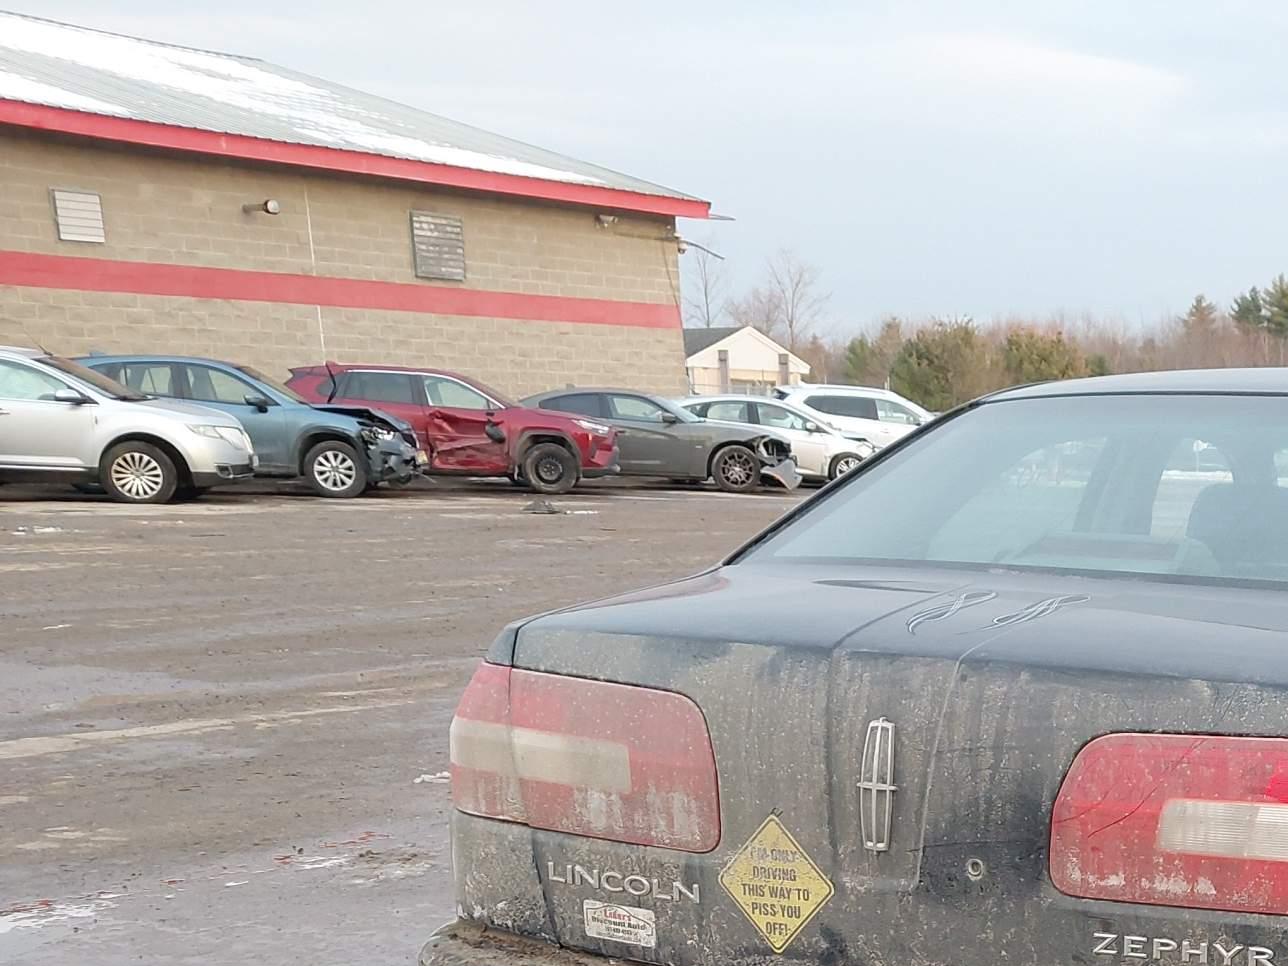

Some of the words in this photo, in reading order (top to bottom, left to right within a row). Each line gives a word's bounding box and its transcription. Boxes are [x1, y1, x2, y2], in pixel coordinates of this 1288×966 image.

[547, 861, 700, 903] LINCOLN
[753, 866, 797, 882] DRIVING
[741, 883, 765, 898] THIS
[768, 886, 793, 900] WAY
[794, 888, 810, 901] TO
[751, 902, 777, 917] PISS
[780, 905, 801, 919] YOU
[765, 921, 788, 936] OFF!
